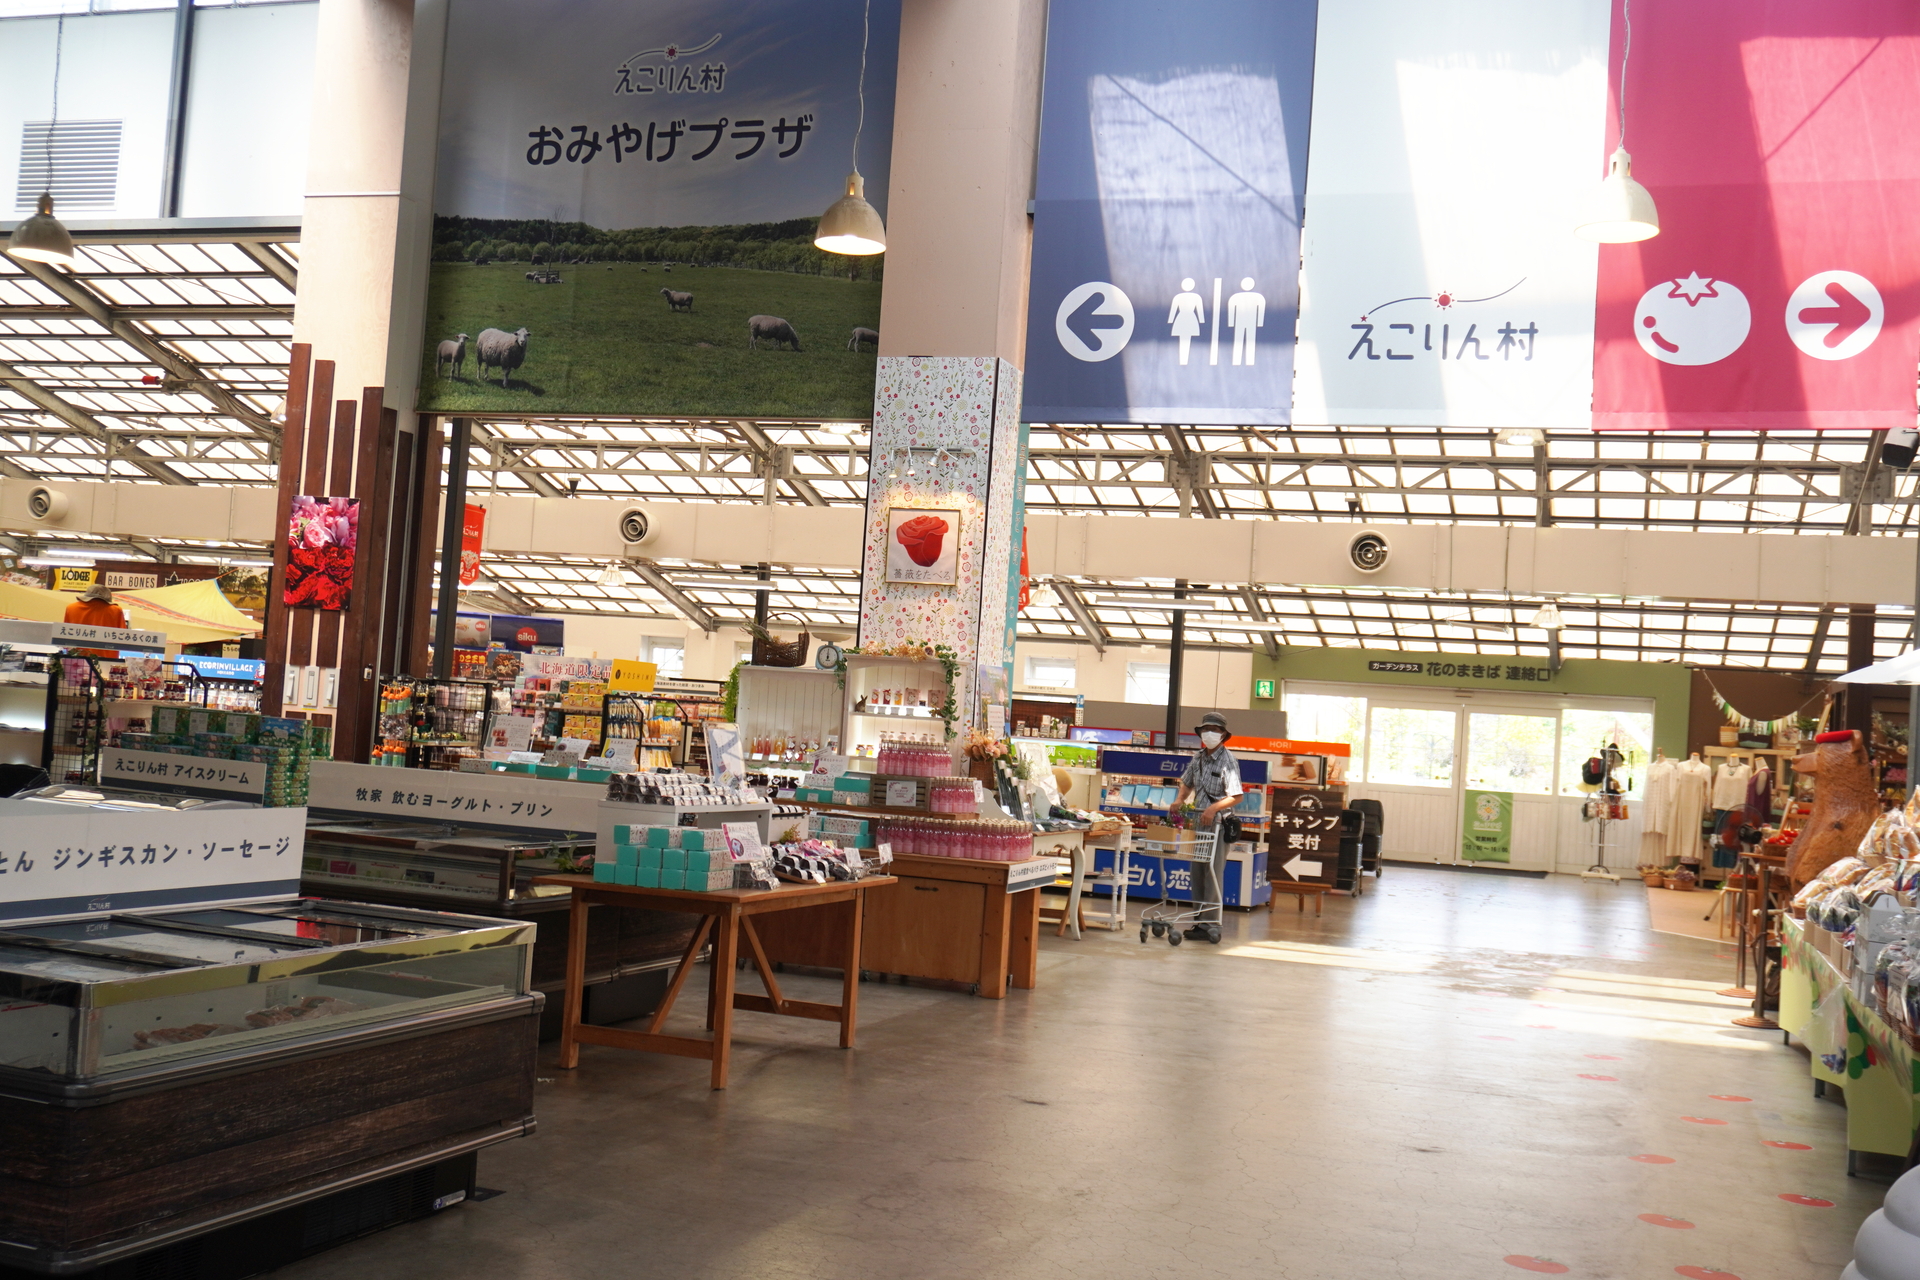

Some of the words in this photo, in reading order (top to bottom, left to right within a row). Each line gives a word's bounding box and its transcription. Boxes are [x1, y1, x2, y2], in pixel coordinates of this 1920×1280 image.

[615, 63, 726, 94] えこりん村
[526, 113, 813, 166] おみやげプラザ
[1348, 320, 1539, 362] えこりん村
[61, 570, 90, 582] LODGE
[108, 575, 123, 587] BAR
[128, 576, 156, 589] BONES
[893, 568, 952, 580] 薔薇をたべる
[60, 627, 96, 638] えこりん村
[104, 631, 158, 643] いちごみるくの素
[517, 633, 537, 642] siku
[1371, 662, 1419, 672] ガーデンテラス
[1426, 661, 1502, 679] 花のまきば
[1506, 665, 1551, 682] 連絡口
[1269, 741, 1292, 749] HORI
[115, 757, 169, 777] えこりん村
[174, 764, 250, 785] アイスクリーム
[355, 787, 383, 803] 牧家
[391, 790, 553, 818] 飲むヨーグルト・プリン
[1274, 812, 1340, 831] キャンプ
[1288, 833, 1321, 851] 受付
[53, 836, 291, 872] ジンギスカン・ソーセージ
[1127, 864, 1192, 891] 白い恋
